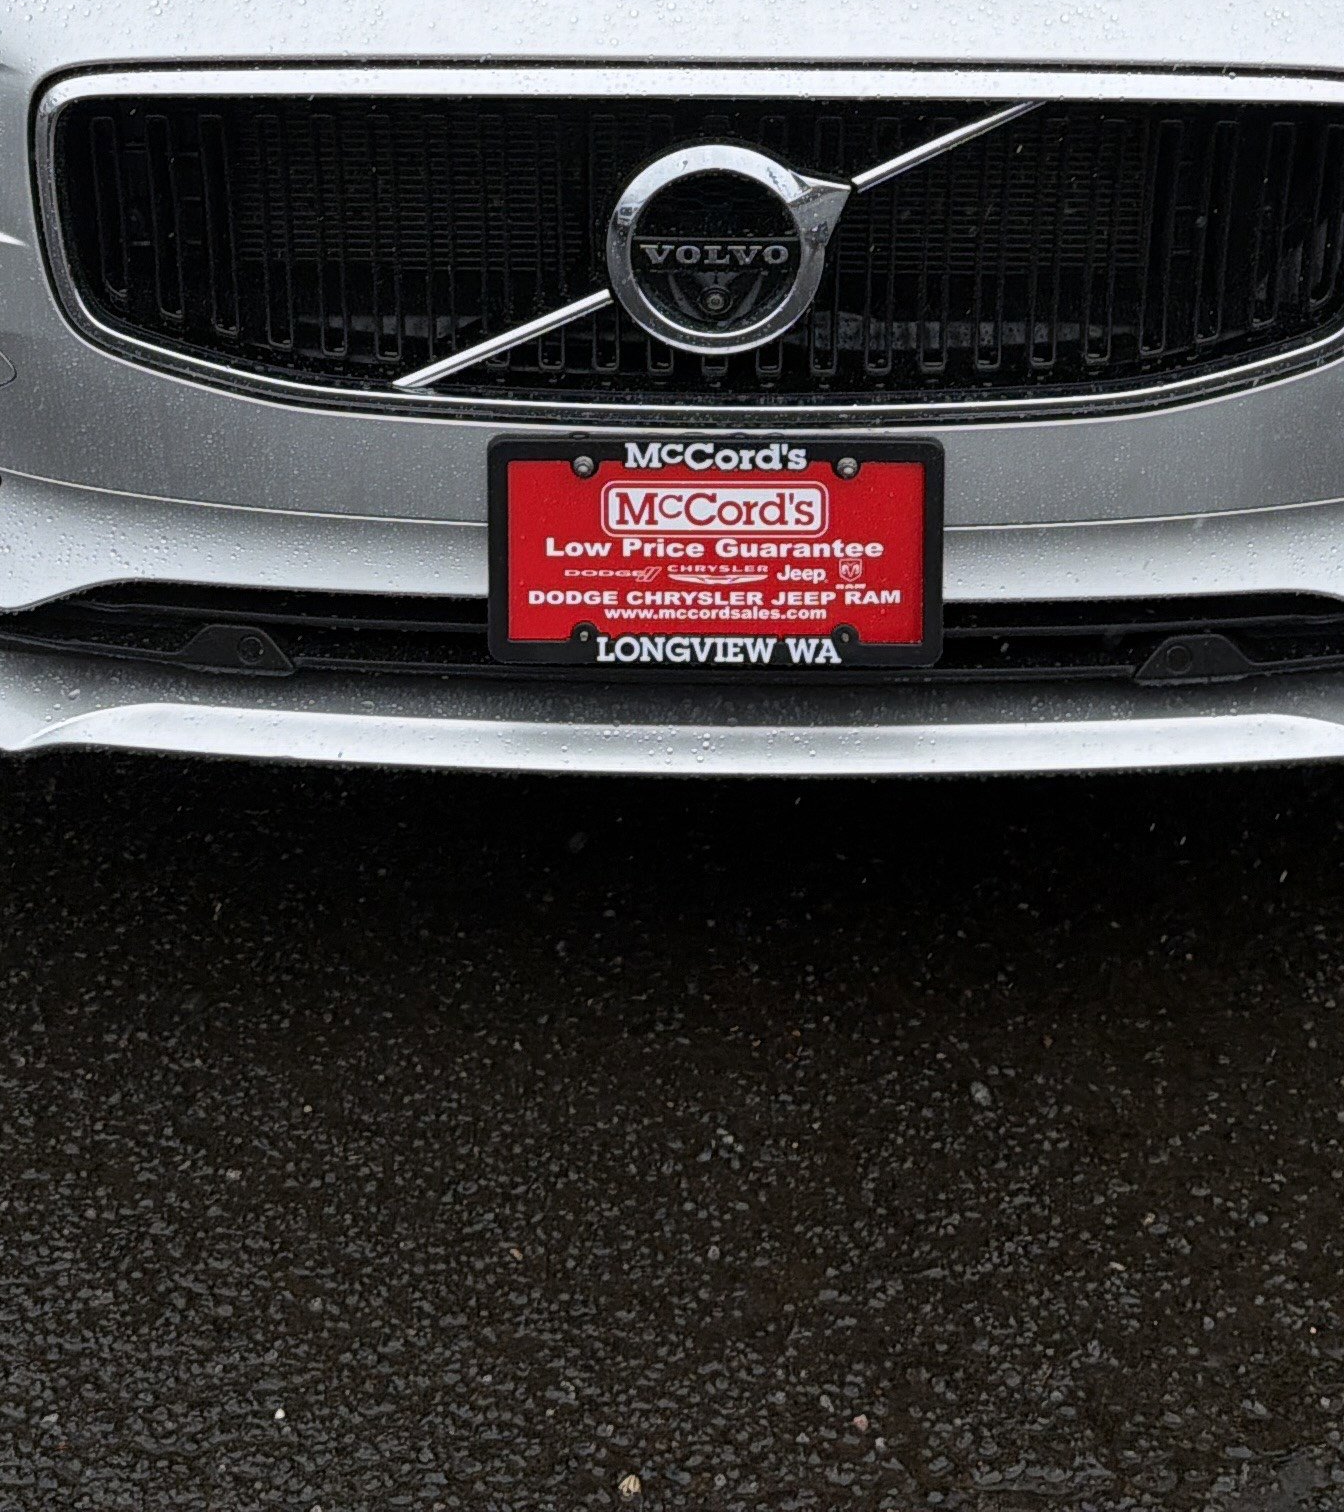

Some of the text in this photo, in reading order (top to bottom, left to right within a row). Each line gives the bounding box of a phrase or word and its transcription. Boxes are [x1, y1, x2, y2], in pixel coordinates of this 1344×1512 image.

[640, 244, 789, 265] VOLVO
[624, 442, 807, 471] McCord's
[615, 492, 815, 527] McCord's
[546, 538, 884, 557] Low Price Guarantee
[667, 565, 769, 573] CHRYSLER
[776, 564, 827, 584] Jeep
[528, 590, 901, 606] DODGE CHRYSLER JEEP RAM
[604, 606, 827, 620] www.mccordsales.com
[596, 637, 842, 664] LONGVIEW WA
